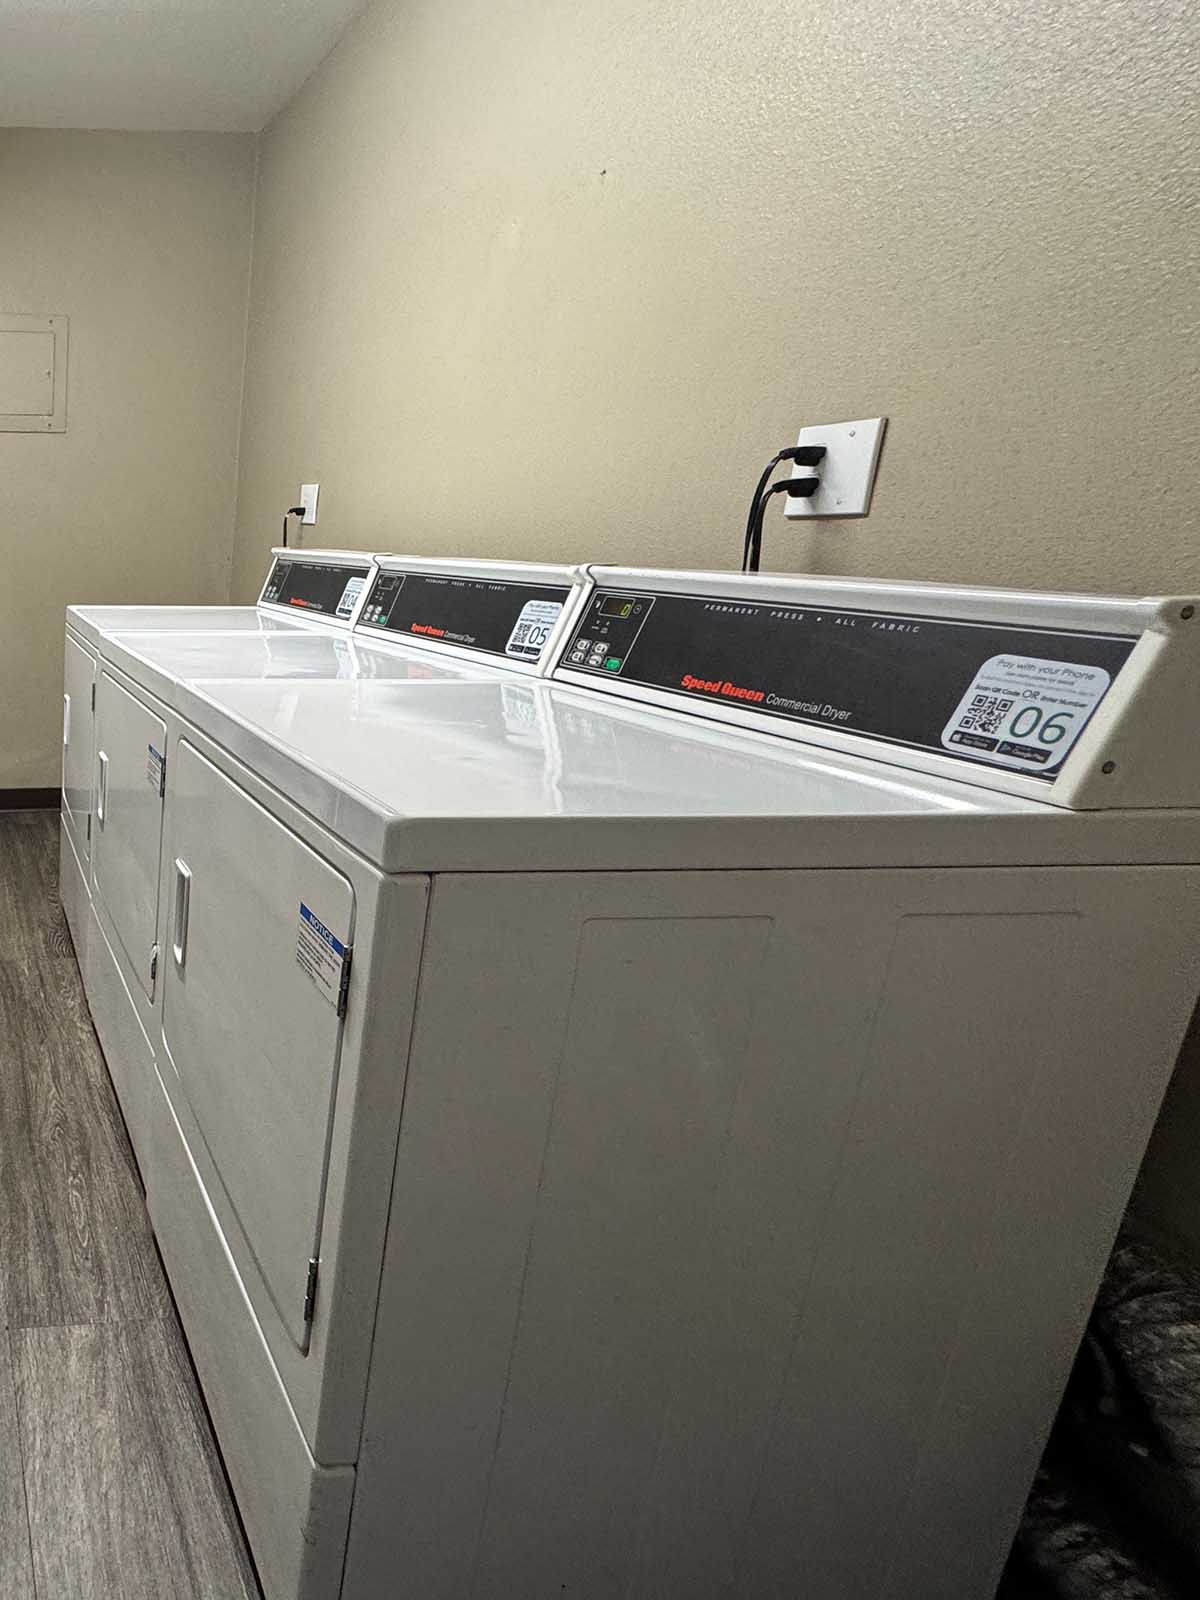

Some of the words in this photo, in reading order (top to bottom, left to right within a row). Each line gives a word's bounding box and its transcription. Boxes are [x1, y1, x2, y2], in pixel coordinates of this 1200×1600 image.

[703, 603, 759, 616] PERMANENT
[769, 610, 804, 622] PRESS
[835, 618, 856, 627] ALL
[871, 621, 921, 633] FABRIC
[528, 626, 550, 646] 05
[996, 659, 1015, 669] Pay
[1016, 663, 1036, 671] with
[1038, 666, 1060, 675] your
[1061, 668, 1096, 681] Phone
[680, 673, 722, 693] Speed
[721, 681, 766, 702] Queen
[766, 693, 822, 715] Commercial
[821, 704, 852, 721] Dryer
[1002, 688, 1020, 697] Code
[1022, 689, 1041, 700] OR
[1009, 706, 1075, 745] 06
[309, 914, 335, 946] NOTICE
